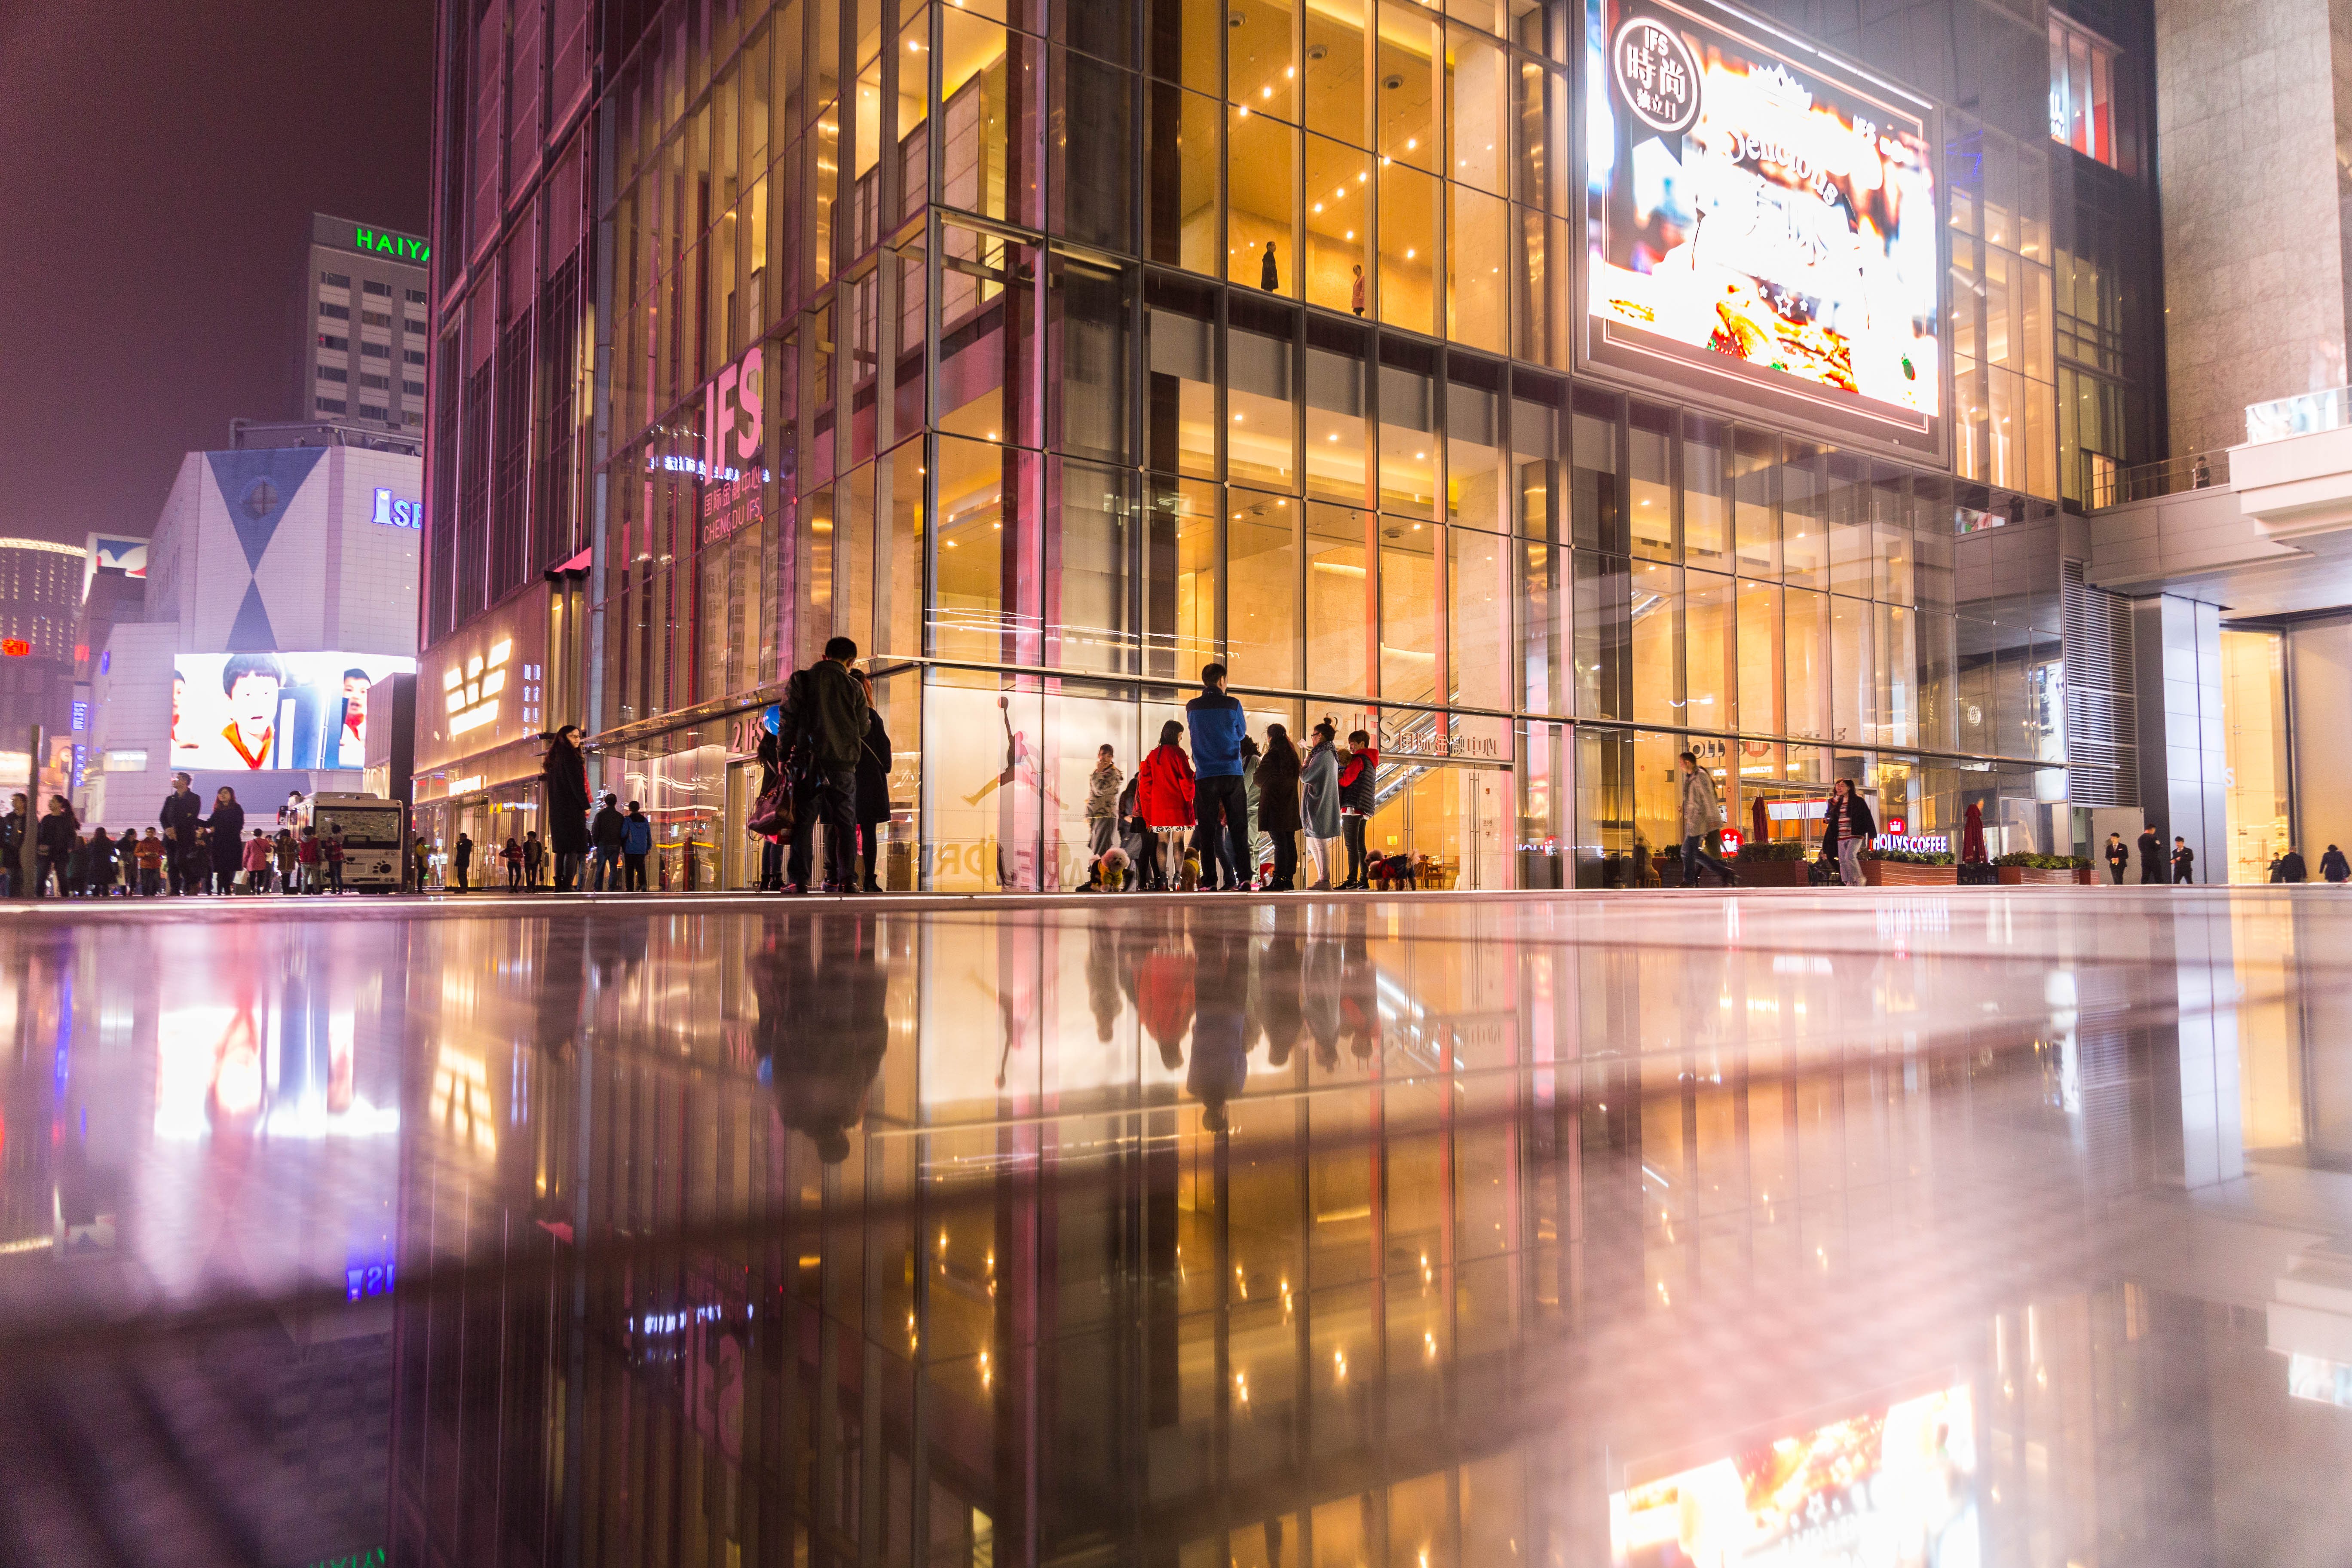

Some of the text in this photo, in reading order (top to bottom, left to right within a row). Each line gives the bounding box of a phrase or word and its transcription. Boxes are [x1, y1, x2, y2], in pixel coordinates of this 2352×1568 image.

[1645, 26, 1669, 56] IFS
[1627, 43, 1685, 104] 時尚
[704, 347, 762, 487] IFS
[704, 466, 760, 518] 国际金融中心
[704, 496, 760, 544] CHENGDU IFS
[732, 717, 765, 753] 2 IFS
[1398, 730, 1498, 756] 国际金融中心
[1873, 833, 1948, 853] HOLLYS COFFEE
